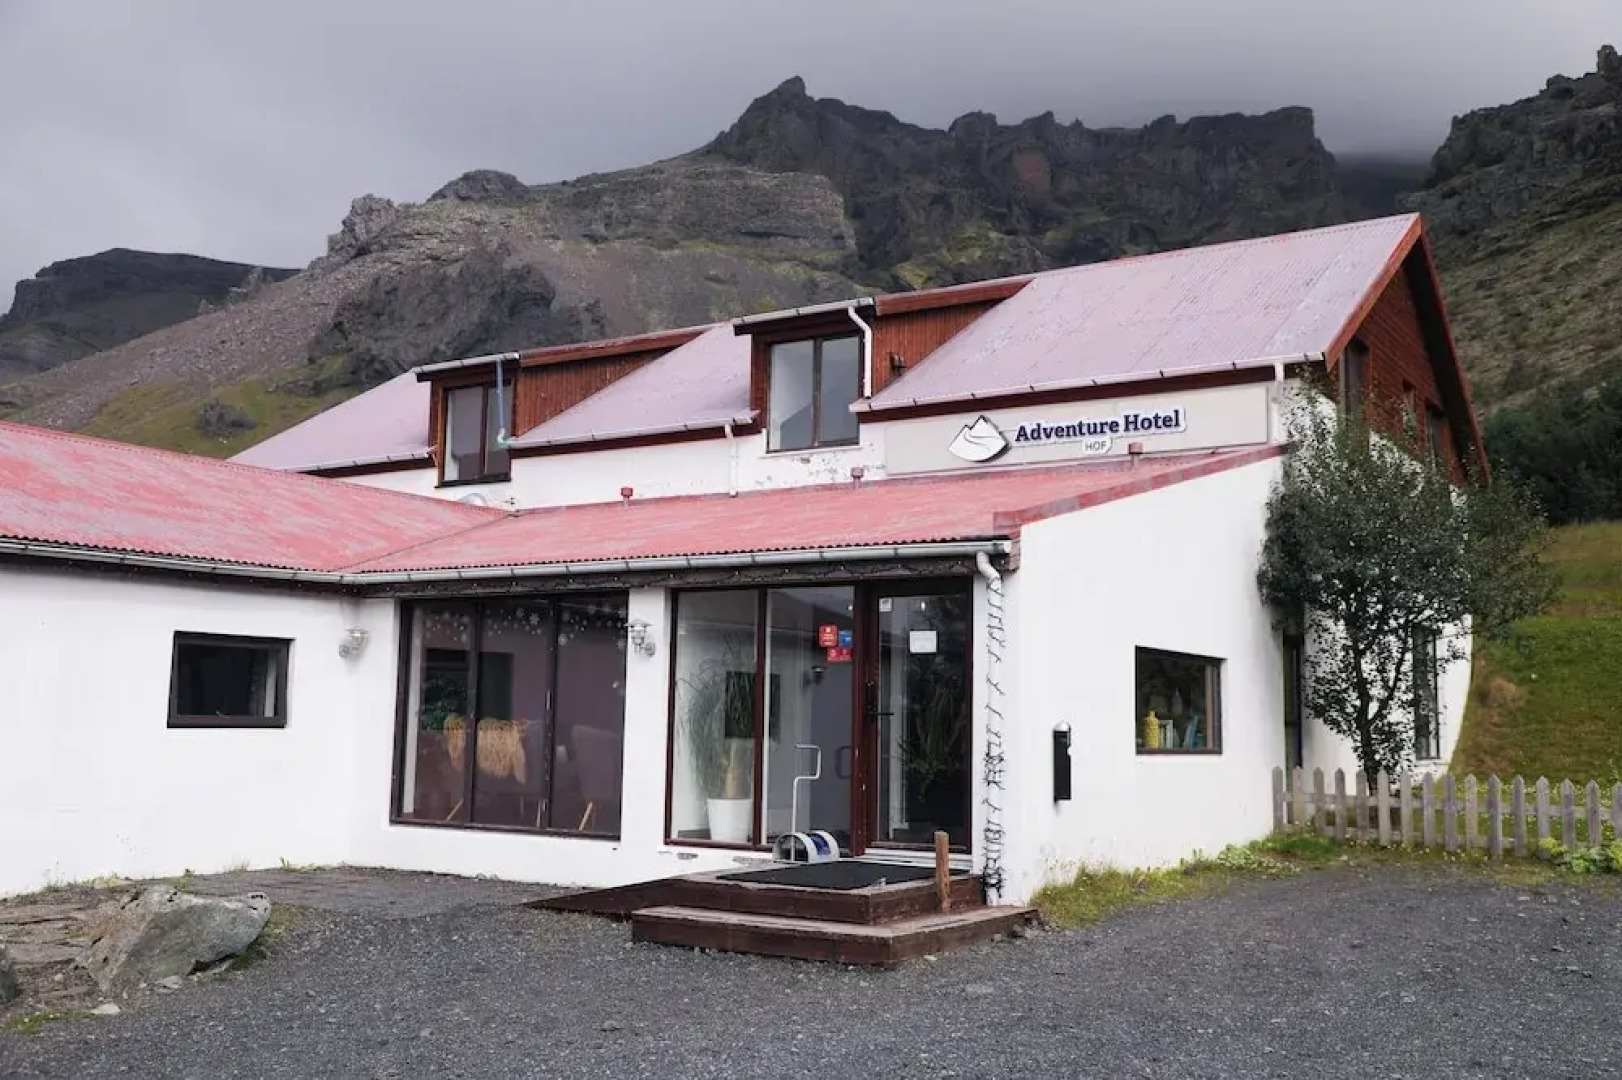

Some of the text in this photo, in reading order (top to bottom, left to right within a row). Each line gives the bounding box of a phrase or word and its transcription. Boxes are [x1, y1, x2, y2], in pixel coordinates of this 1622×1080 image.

[1015, 410, 1180, 442] Adventure Hotel
[1085, 441, 1107, 452] HOF
